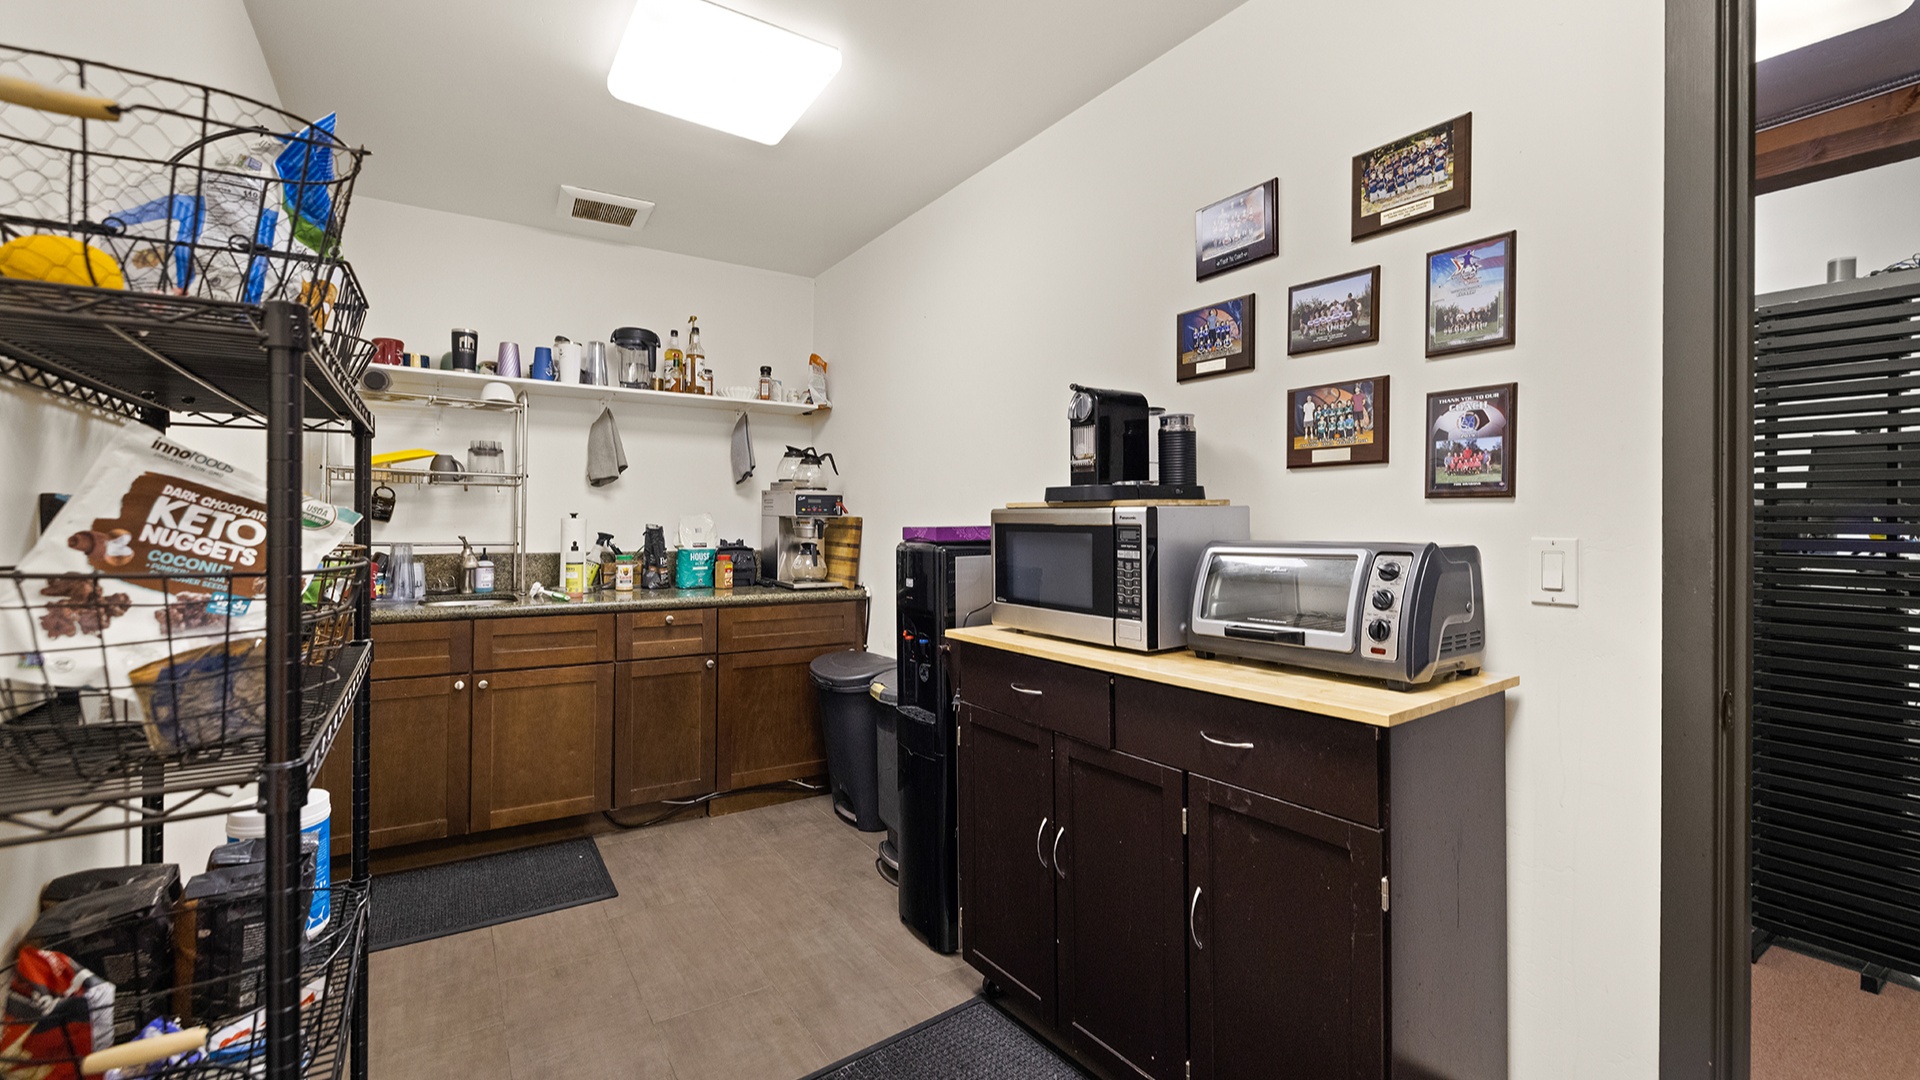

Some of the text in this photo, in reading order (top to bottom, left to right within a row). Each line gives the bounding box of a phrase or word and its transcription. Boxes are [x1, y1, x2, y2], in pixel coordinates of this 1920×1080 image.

[162, 484, 268, 522] DARK CHOCOLATE
[306, 504, 329, 518] USDA
[146, 495, 267, 547] KETO
[302, 513, 327, 526] RGANIC
[138, 523, 258, 567] NUGGETS
[147, 549, 234, 574] COCONUT
